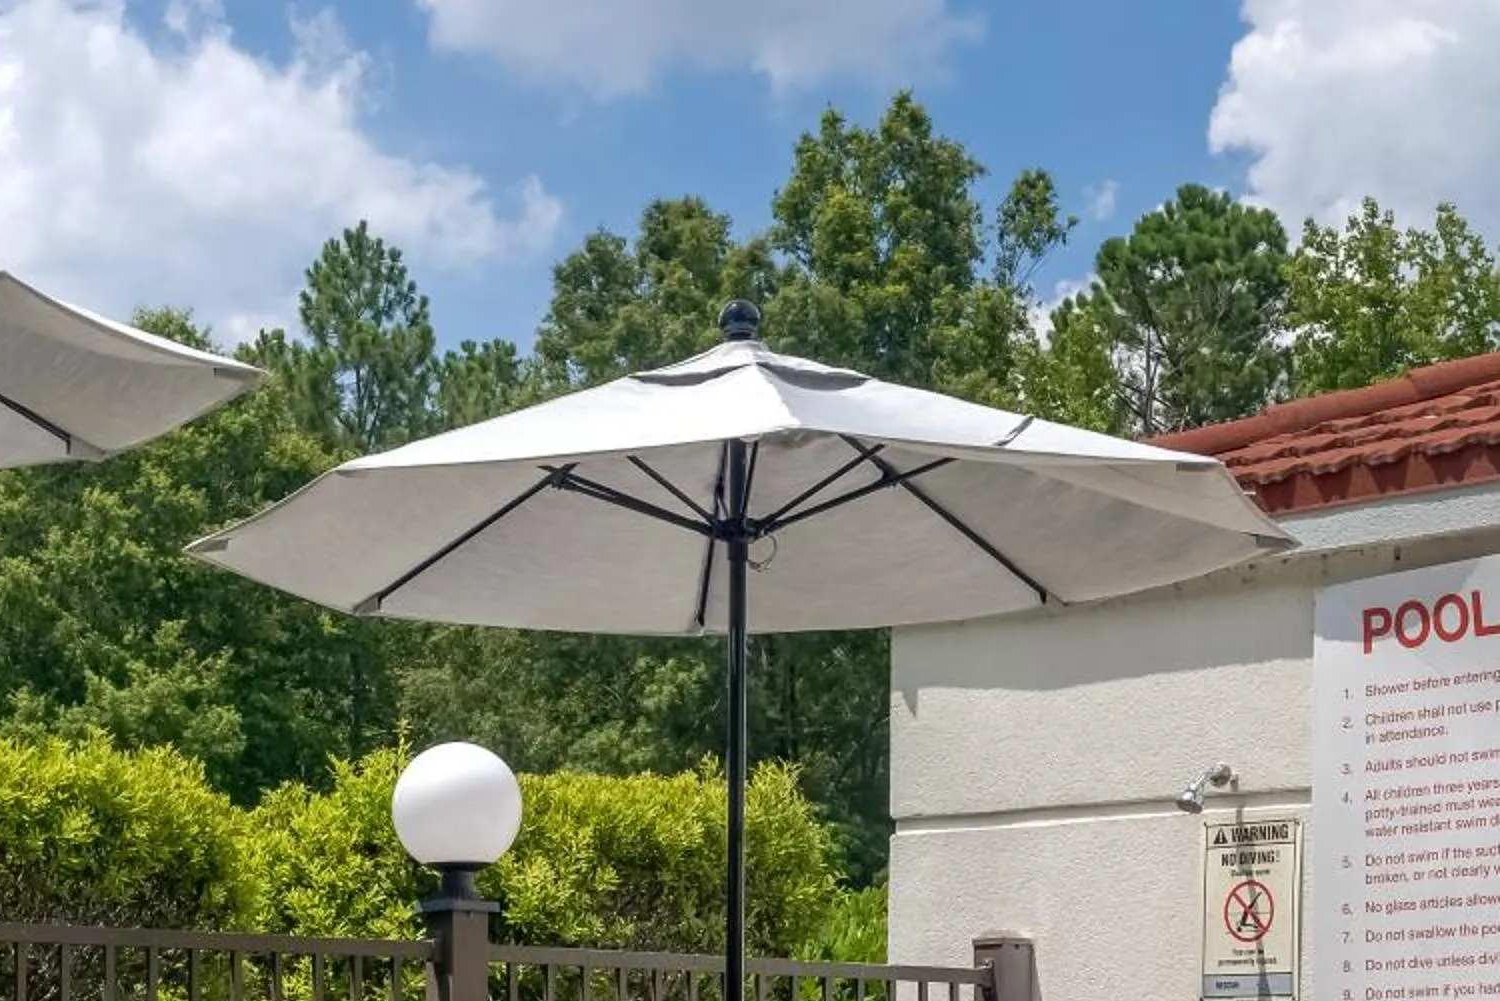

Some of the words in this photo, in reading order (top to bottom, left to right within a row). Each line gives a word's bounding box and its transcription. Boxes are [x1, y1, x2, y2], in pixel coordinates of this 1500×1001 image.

[1363, 590, 1500, 654] POOL
[1365, 682, 1410, 698] Shower
[1412, 676, 1450, 691] before
[1365, 711, 1414, 727] Children
[1417, 705, 1445, 721] shall
[1447, 703, 1466, 717] not
[1469, 701, 1492, 713] use
[1365, 732, 1374, 744] in
[1379, 725, 1449, 743] attendance.
[1365, 758, 1403, 773] Adults
[1405, 753, 1447, 768] should
[1449, 751, 1469, 764] not
[1365, 788, 1380, 802] All
[1383, 783, 1431, 800] children
[1433, 782, 1464, 796] three
[1467, 779, 1500, 795] years
[1445, 798, 1475, 812] must
[1231, 824, 1289, 844] WARNING
[1365, 824, 1399, 838] water
[1401, 819, 1451, 836] resistant
[1455, 816, 1487, 830] swim
[1221, 853, 1237, 867] NO
[1239, 850, 1281, 866] DIVING!
[1365, 855, 1382, 868] Do
[1385, 853, 1405, 866] not
[1407, 850, 1439, 864] swim
[1441, 847, 1451, 861] if
[1453, 847, 1473, 860] the
[1413, 871, 1426, 882] or
[1428, 867, 1447, 880] not
[1451, 864, 1490, 879] clearly
[1365, 901, 1382, 914] No
[1385, 899, 1417, 916] glass
[1419, 895, 1463, 911] articles
[1365, 929, 1382, 943] Do
[1385, 929, 1405, 942] not
[1407, 925, 1456, 941] swallow
[1459, 923, 1479, 937] the
[1365, 959, 1382, 971] Do
[1385, 958, 1405, 971] not
[1408, 955, 1433, 970] dive
[1437, 953, 1475, 968] unless
[1365, 987, 1382, 1001] Do
[1385, 987, 1405, 1000] not
[1408, 985, 1439, 999] swim
[1443, 983, 1452, 997] if
[1453, 985, 1475, 1000] you
